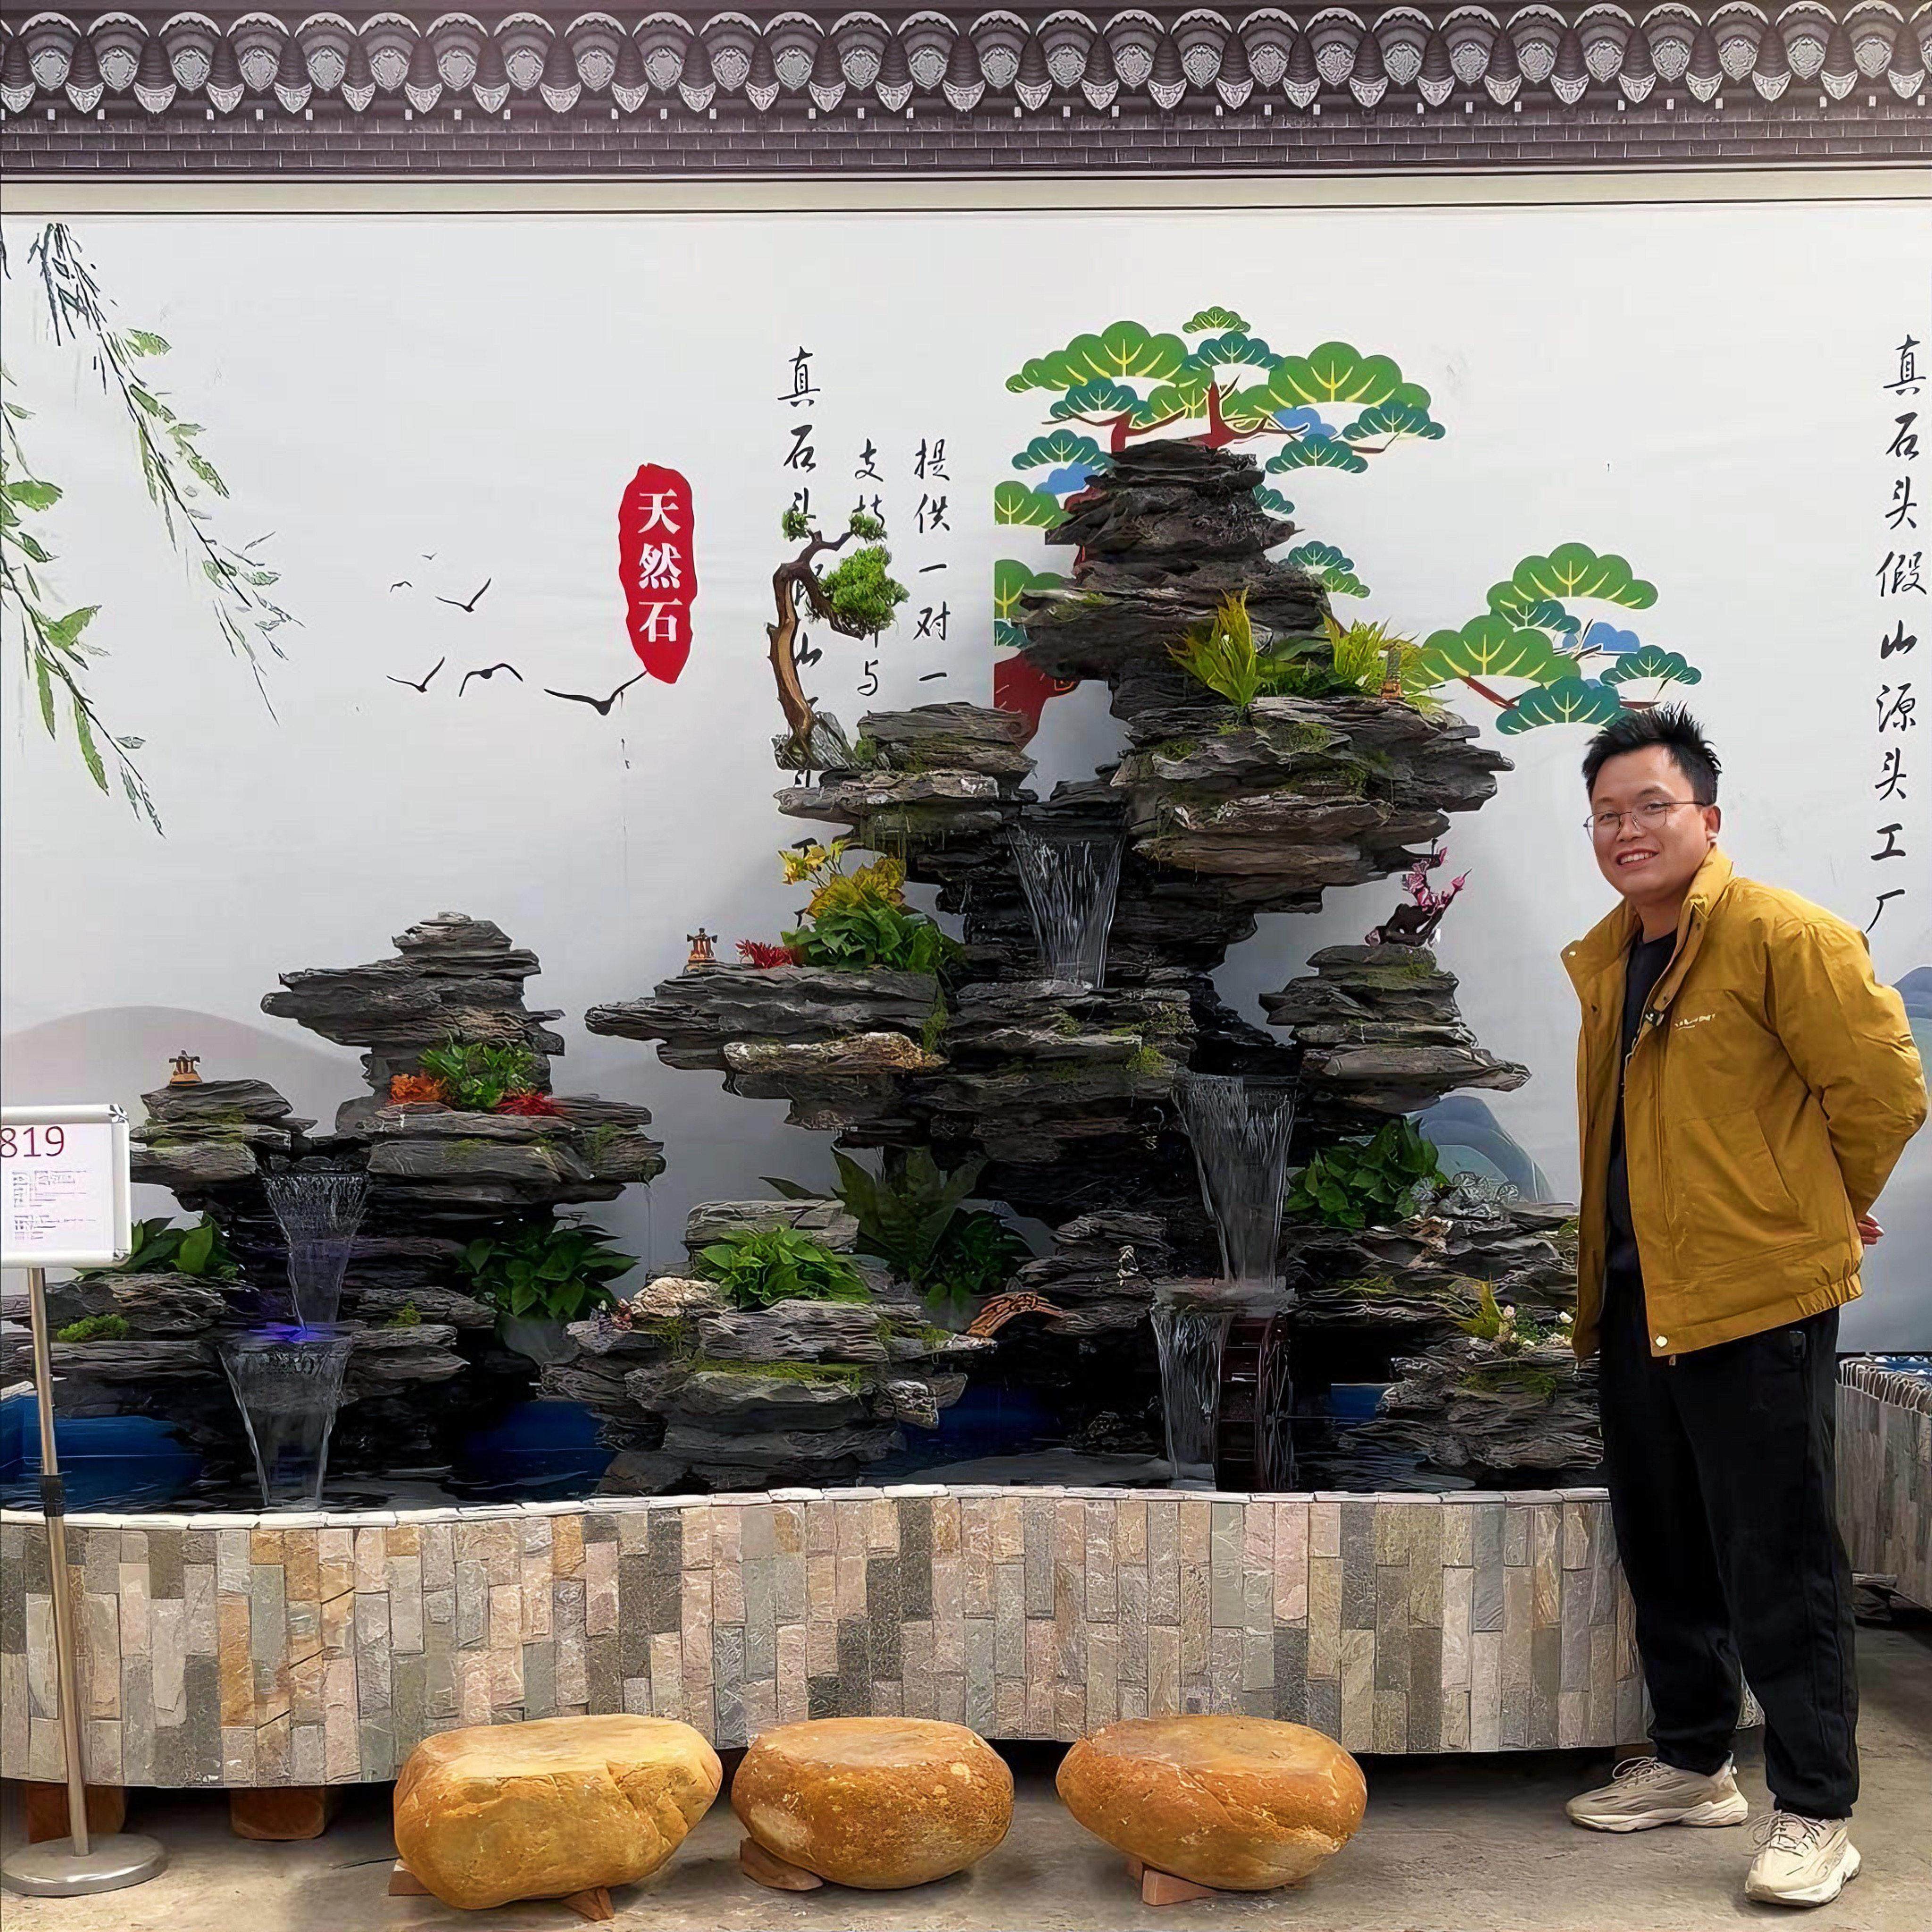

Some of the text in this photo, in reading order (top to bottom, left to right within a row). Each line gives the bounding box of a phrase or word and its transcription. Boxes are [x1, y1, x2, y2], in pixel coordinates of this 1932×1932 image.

[638, 490, 682, 642] 天然石
[913, 439, 951, 681] 提供一对一
[1865, 334, 1927, 934] 真石头假山源头工厂
[0, 1126, 64, 1158] 819
